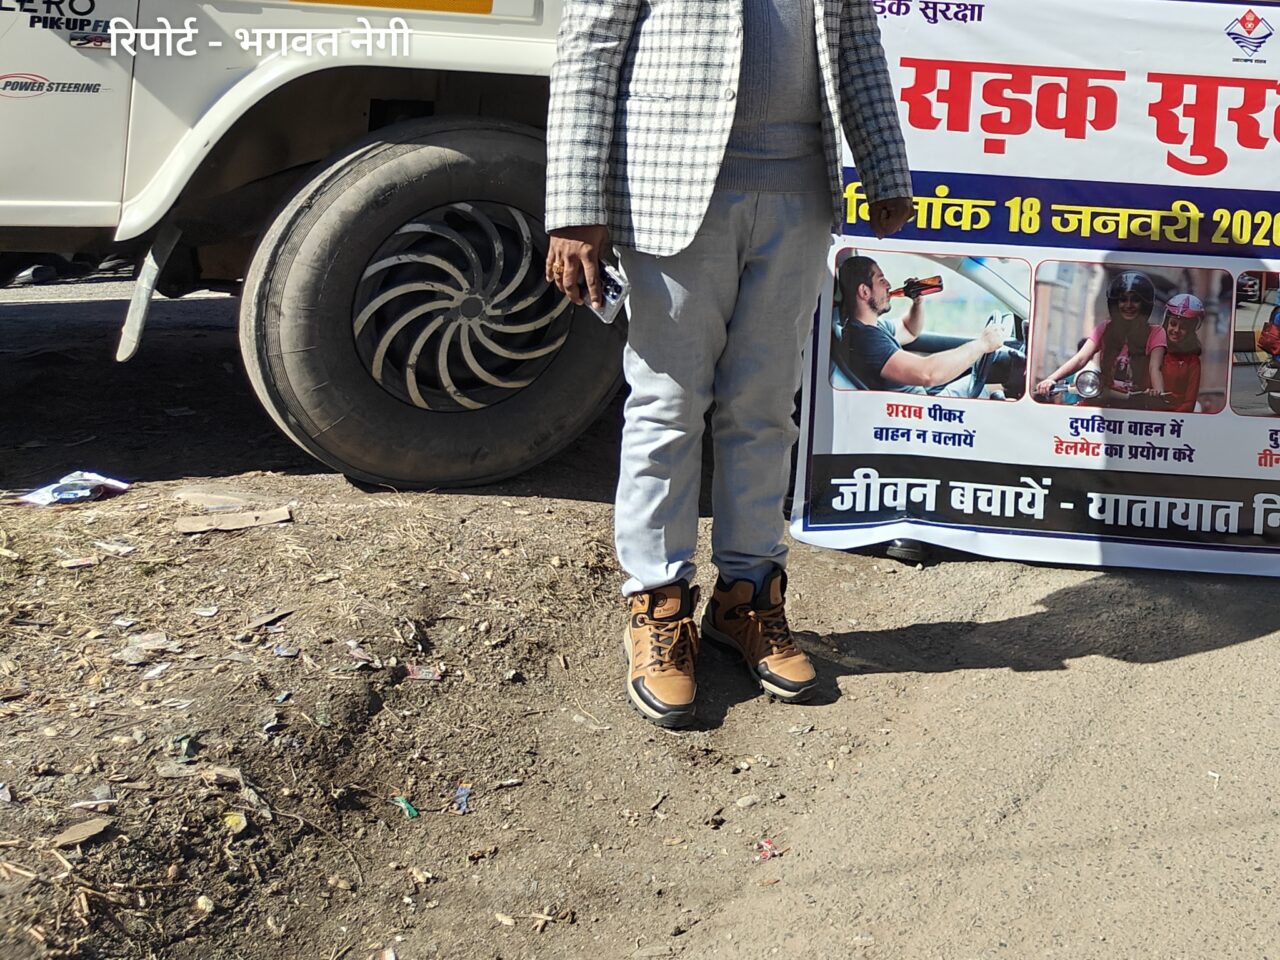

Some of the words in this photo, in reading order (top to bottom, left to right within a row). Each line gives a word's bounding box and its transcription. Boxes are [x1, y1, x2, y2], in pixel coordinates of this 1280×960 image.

[29, 15, 91, 31] PIK-UP
[918, 0, 985, 24] सुरक्षा
[3, 80, 46, 92] POWER
[46, 82, 101, 93] STEERING
[900, 57, 1126, 154] सड़क
[1004, 196, 1040, 234] 18
[1051, 200, 1204, 243] जनवरी
[887, 403, 924, 419] शराब
[927, 404, 965, 423] पीकर
[916, 429, 928, 443] न
[932, 429, 976, 447] चलायें
[1069, 415, 1124, 436] दुपहिया
[1128, 421, 1166, 437] वाहन
[1169, 419, 1184, 438] में
[1054, 436, 1102, 456] हेलमेट
[1104, 443, 1124, 458] का
[1128, 442, 1169, 461] प्रयोग
[1172, 444, 1195, 463] करे
[831, 468, 940, 512] जीवन
[949, 477, 1051, 519] बचायें
[1059, 501, 1074, 509] -
[1087, 492, 1243, 532] यातायात
